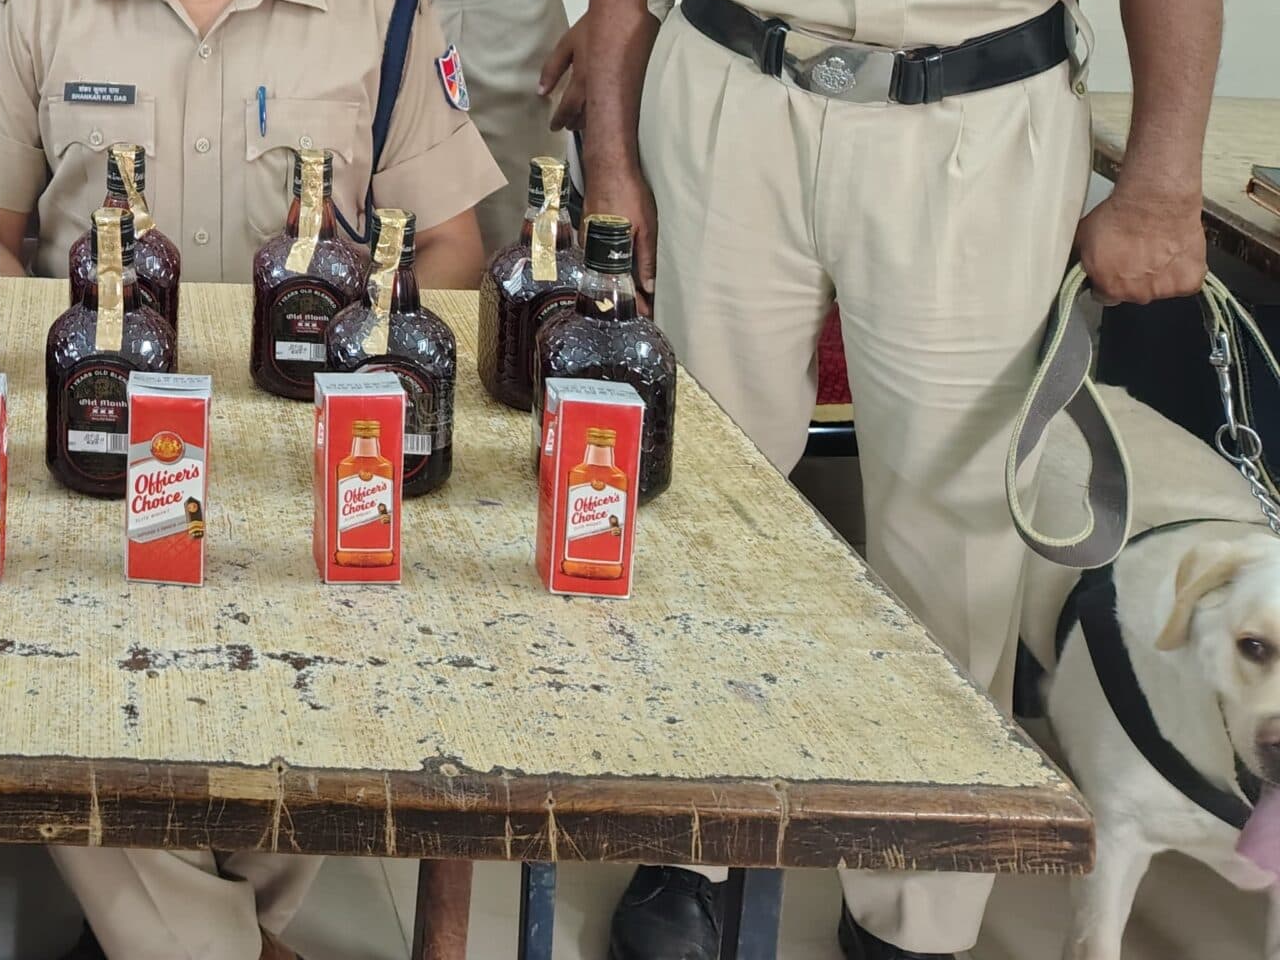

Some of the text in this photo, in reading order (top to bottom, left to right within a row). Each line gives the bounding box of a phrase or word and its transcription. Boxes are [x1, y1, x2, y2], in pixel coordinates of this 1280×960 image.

[100, 399, 128, 407] Monk
[134, 464, 200, 496] Officer's
[131, 491, 183, 514] Choice
[343, 481, 387, 503] Officer's
[574, 492, 620, 513] Officer's
[342, 500, 376, 516] Choice
[571, 510, 608, 525] Choice
